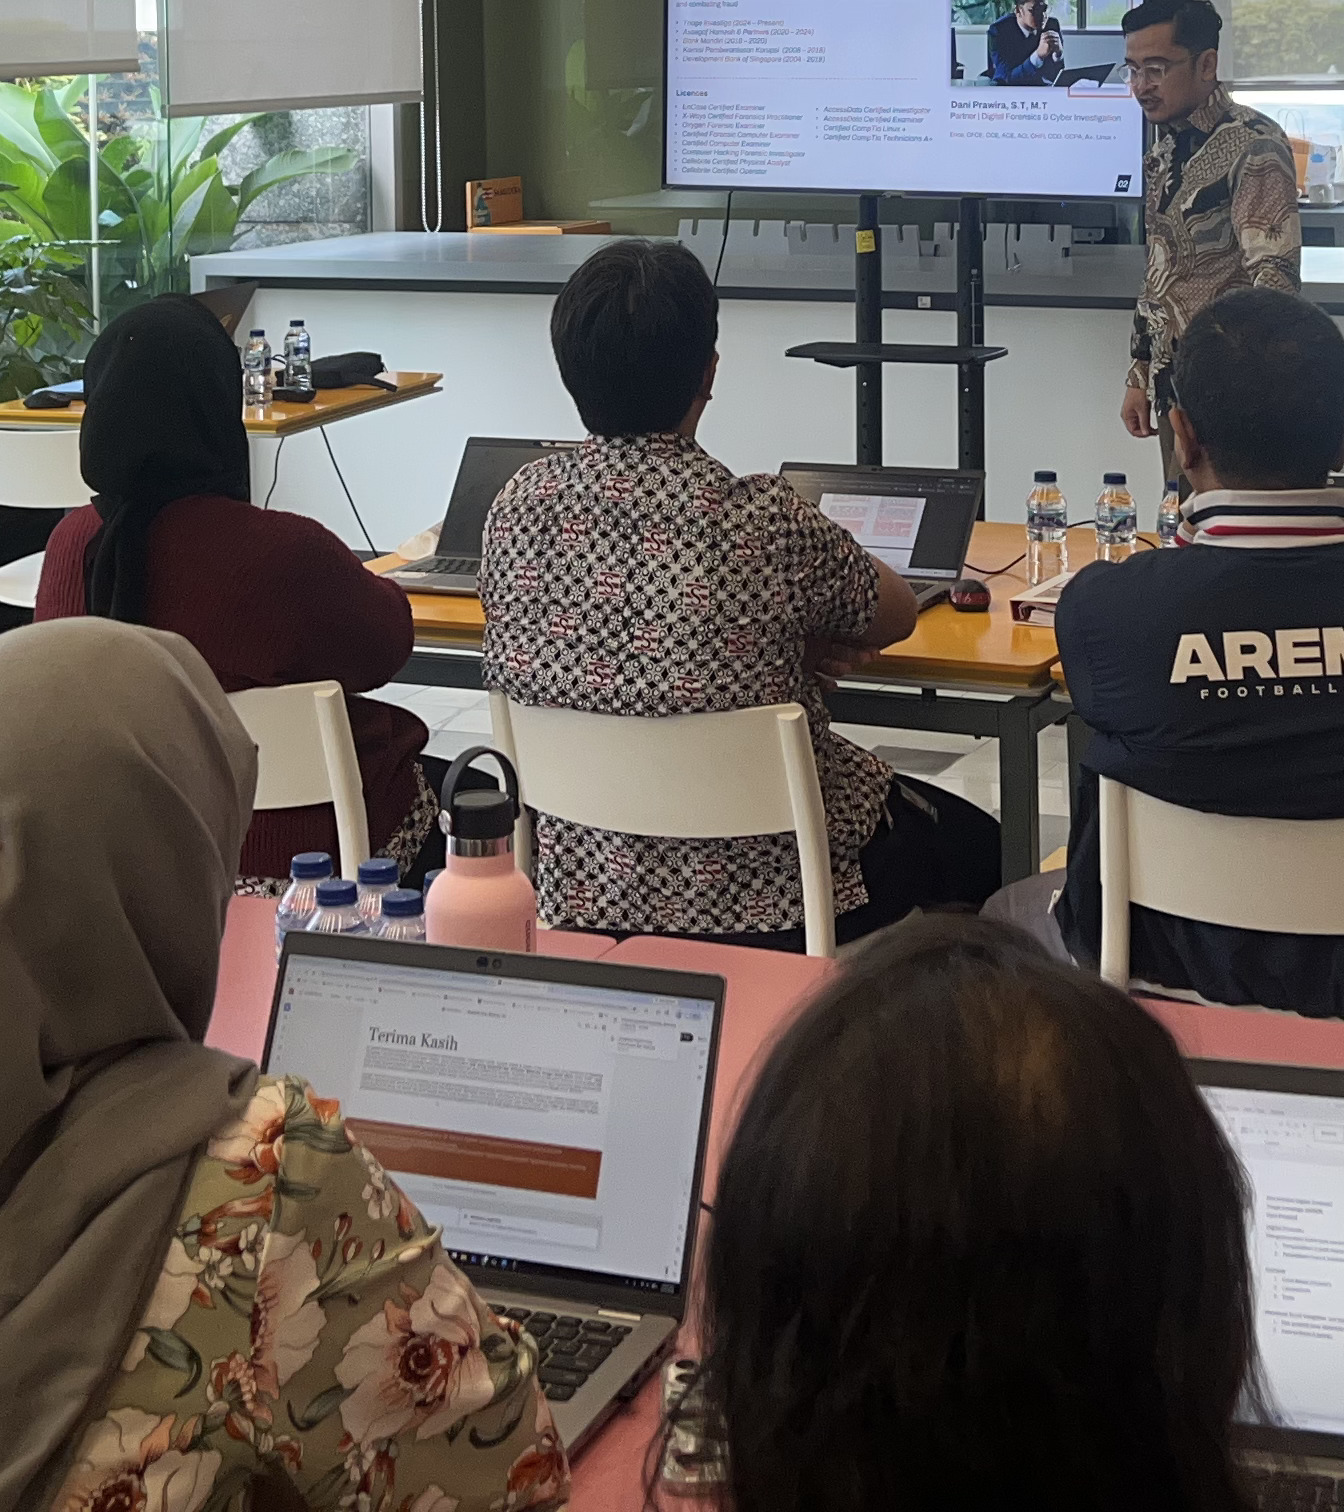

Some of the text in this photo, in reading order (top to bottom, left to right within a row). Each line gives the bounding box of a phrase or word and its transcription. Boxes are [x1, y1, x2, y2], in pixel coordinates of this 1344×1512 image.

[951, 101, 970, 109] Dani
[973, 101, 1008, 110] Prawira,
[982, 113, 1004, 121] Digital
[1050, 114, 1072, 122] Cyber
[1117, 179, 1129, 189] 02
[1200, 682, 1338, 700] FOOTBALL
[369, 1027, 459, 1052] Terima Kasih
